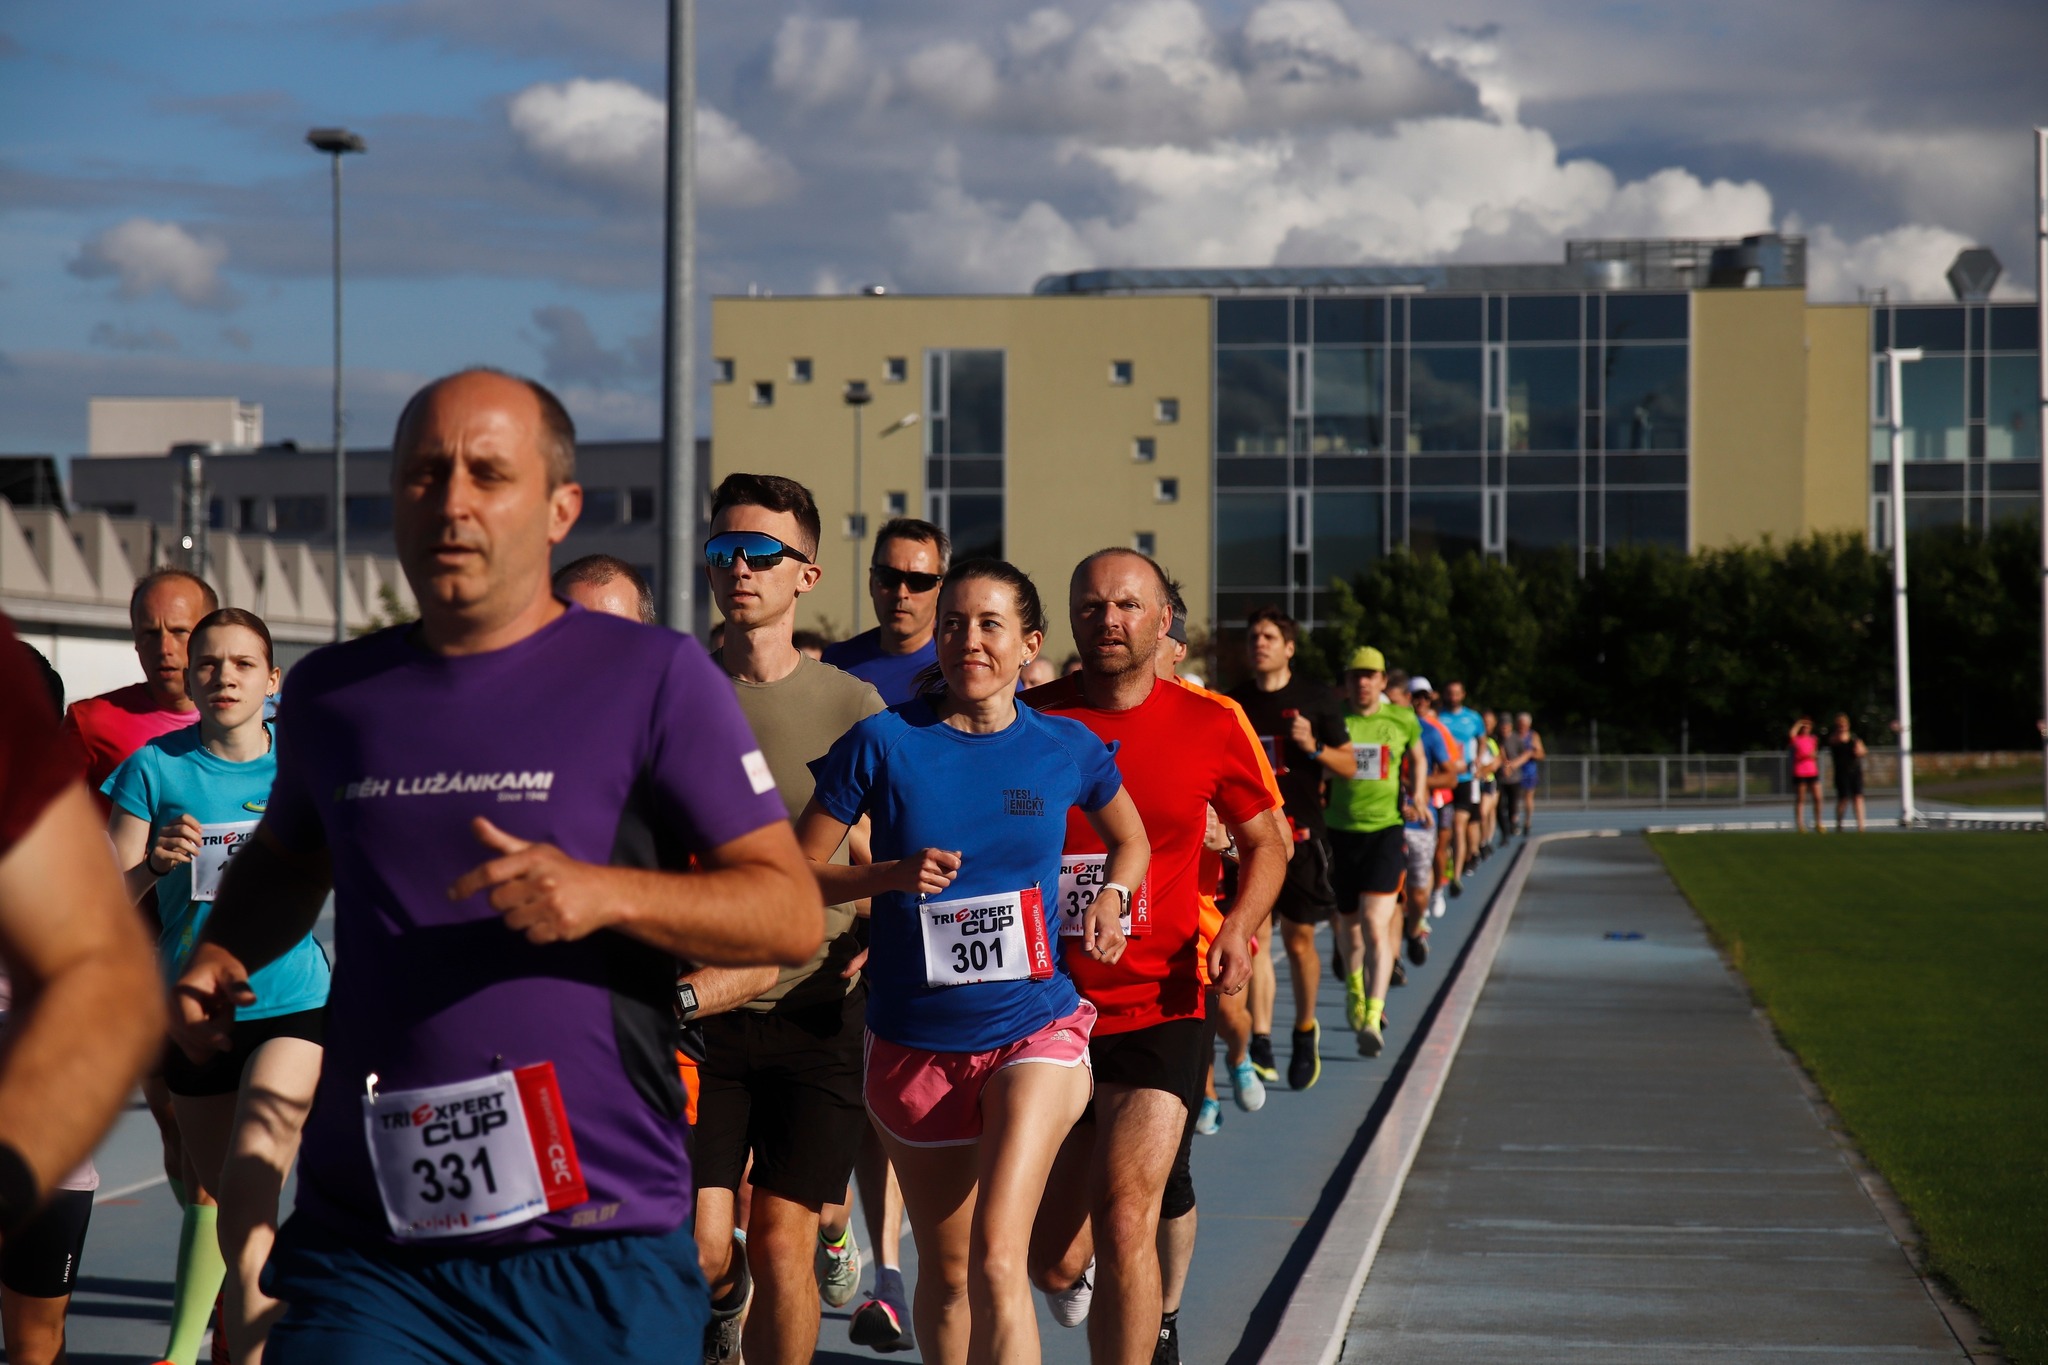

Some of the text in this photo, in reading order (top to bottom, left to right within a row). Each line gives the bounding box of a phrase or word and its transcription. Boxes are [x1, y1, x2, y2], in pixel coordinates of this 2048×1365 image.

[395, 771, 554, 795] LUŽÁNKAMI
[1009, 789, 1031, 799] YES!
[202, 832, 253, 846] TRIEXP
[1060, 863, 1105, 875] RIEXP
[1076, 874, 1104, 885] CU
[932, 905, 1014, 925] TRIEXPERT
[1066, 890, 1095, 917] 33
[961, 916, 1014, 936] CUP
[1032, 904, 1045, 941] ČASOMÍRA
[951, 938, 1003, 974] 301
[381, 1092, 504, 1130] TRIEXPERT
[422, 1110, 508, 1147] CUP
[412, 1145, 497, 1204] 331
